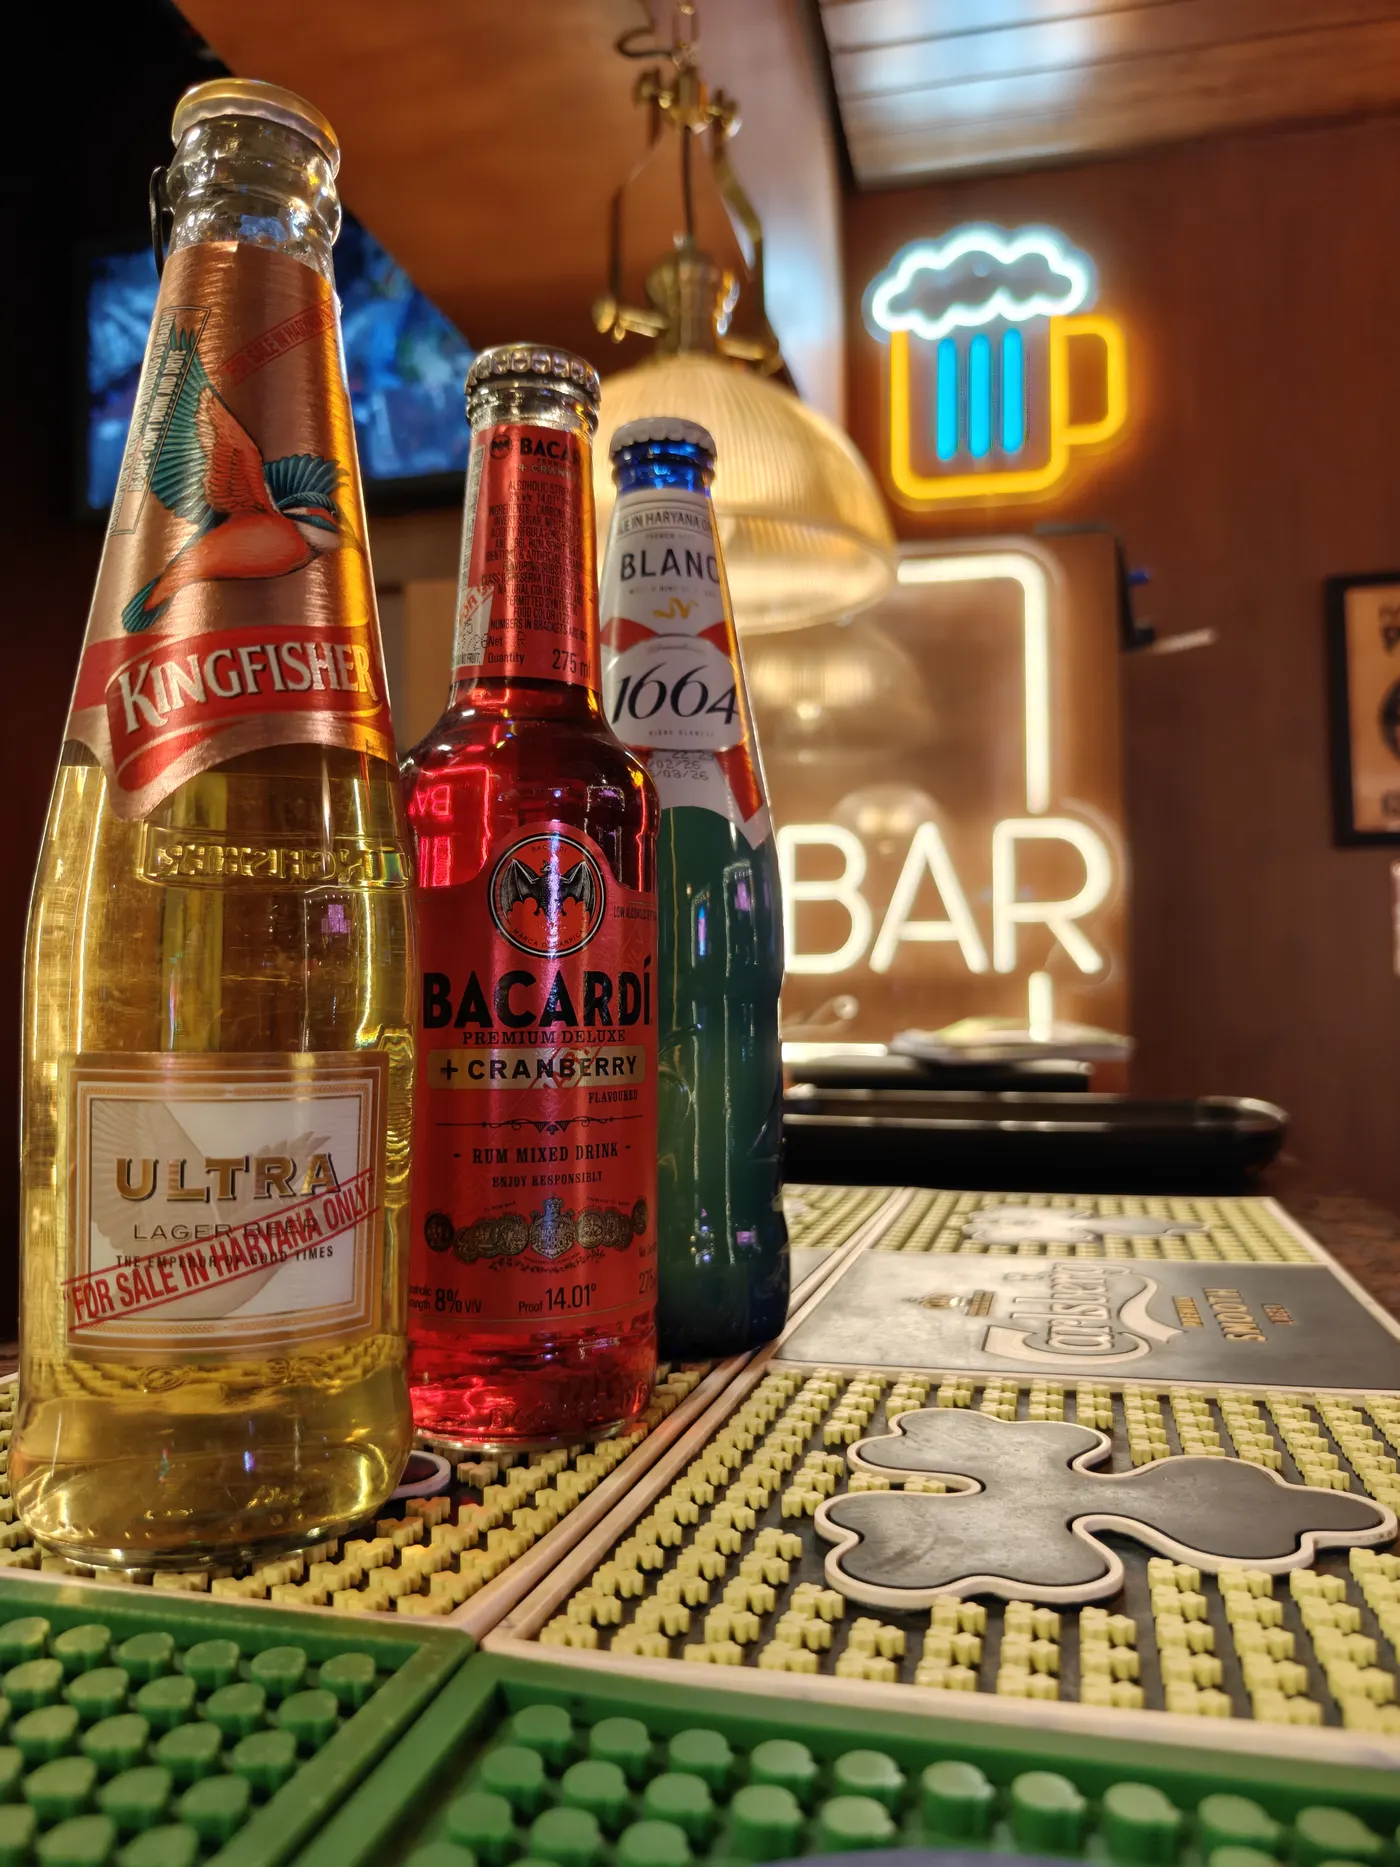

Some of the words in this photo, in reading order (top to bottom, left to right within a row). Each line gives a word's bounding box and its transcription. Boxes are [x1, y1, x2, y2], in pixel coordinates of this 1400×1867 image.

[154, 313, 176, 347] HEALTH
[163, 349, 187, 375] DRIVE
[157, 375, 178, 396] AND
[148, 394, 172, 422] DRINK
[141, 423, 162, 452] DON'T
[133, 458, 151, 481] SAFE
[644, 510, 700, 528] HARYANA
[620, 548, 720, 585] BLANC
[491, 618, 524, 631] NUMBERS
[487, 635, 503, 648] Net
[487, 651, 525, 666] Quantity
[552, 648, 578, 675] 275
[117, 641, 380, 735] KINGFISHER
[611, 661, 740, 725] 1664
[775, 816, 1112, 975] BAR
[613, 905, 625, 918] LOW
[513, 928, 539, 947] MARCA
[422, 957, 651, 1030] BACARDÍ
[462, 1030, 556, 1046] PREMIUM
[560, 1029, 626, 1044] DELUXE
[467, 1055, 637, 1081] CRANBERRY
[588, 1089, 639, 1104] FLAVOURED
[472, 1148, 508, 1165] RUM
[515, 1146, 569, 1164] MIXED
[576, 1142, 620, 1160] DRINK
[115, 1152, 342, 1203] ULTRA
[492, 1175, 527, 1188] ENJOY
[531, 1170, 603, 1187] RESPONSIBLY
[133, 1222, 233, 1242] LAGER
[115, 1262, 179, 1308] SALE
[178, 1248, 210, 1288] IN
[209, 1207, 323, 1278] HARYANA
[116, 1254, 140, 1268] THE
[296, 1245, 334, 1262] TIMES
[434, 1287, 462, 1314] 8%
[518, 1300, 543, 1314] Proof
[981, 1261, 1153, 1366] Carlsberg
[1202, 1286, 1268, 1342] SMOOTH
